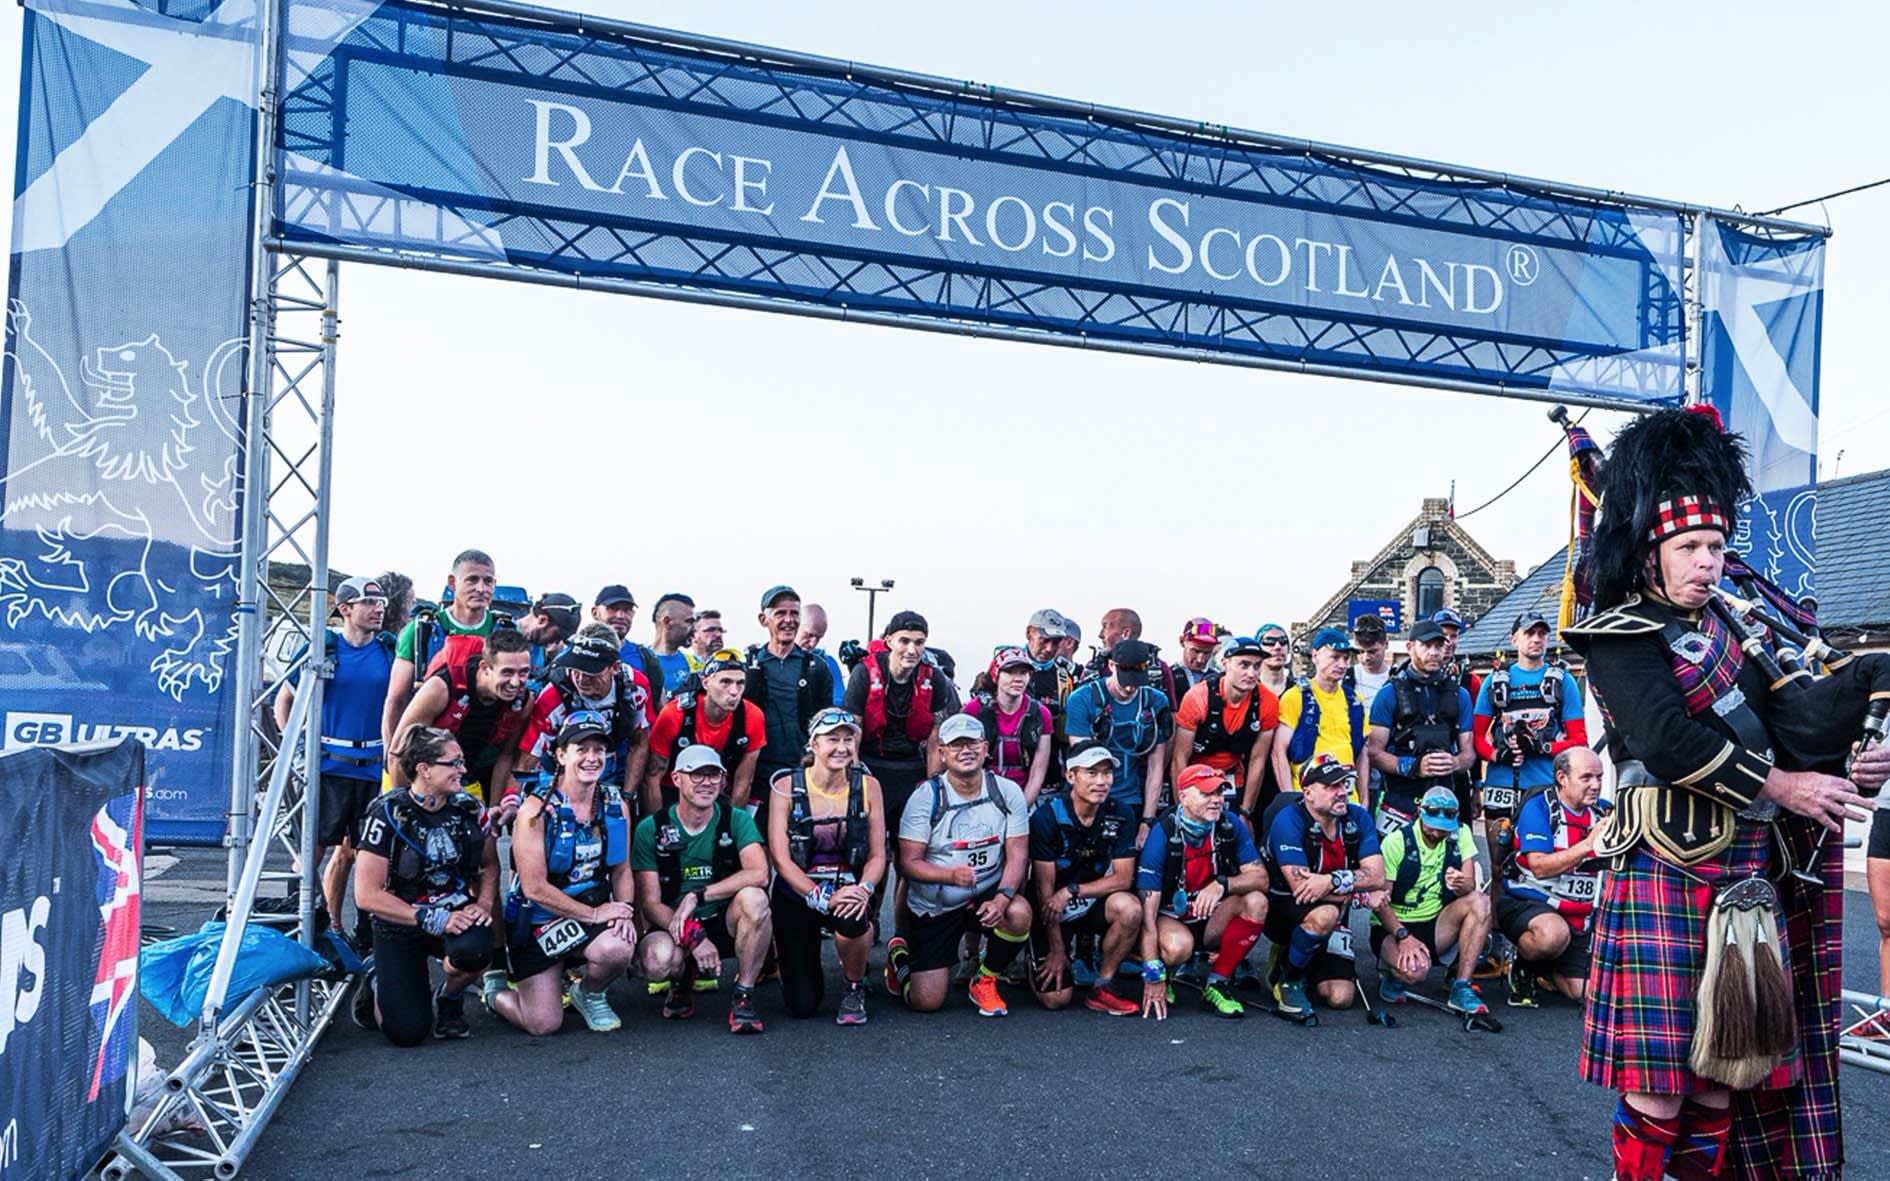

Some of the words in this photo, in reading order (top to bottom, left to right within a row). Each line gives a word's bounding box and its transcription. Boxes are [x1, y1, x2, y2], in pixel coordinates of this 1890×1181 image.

[13, 721, 65, 744] GB
[1486, 788, 1513, 805] 185
[1383, 815, 1402, 833] 77
[967, 850, 987, 868] 35
[1567, 879, 1594, 896] 138
[544, 921, 580, 954] 440
